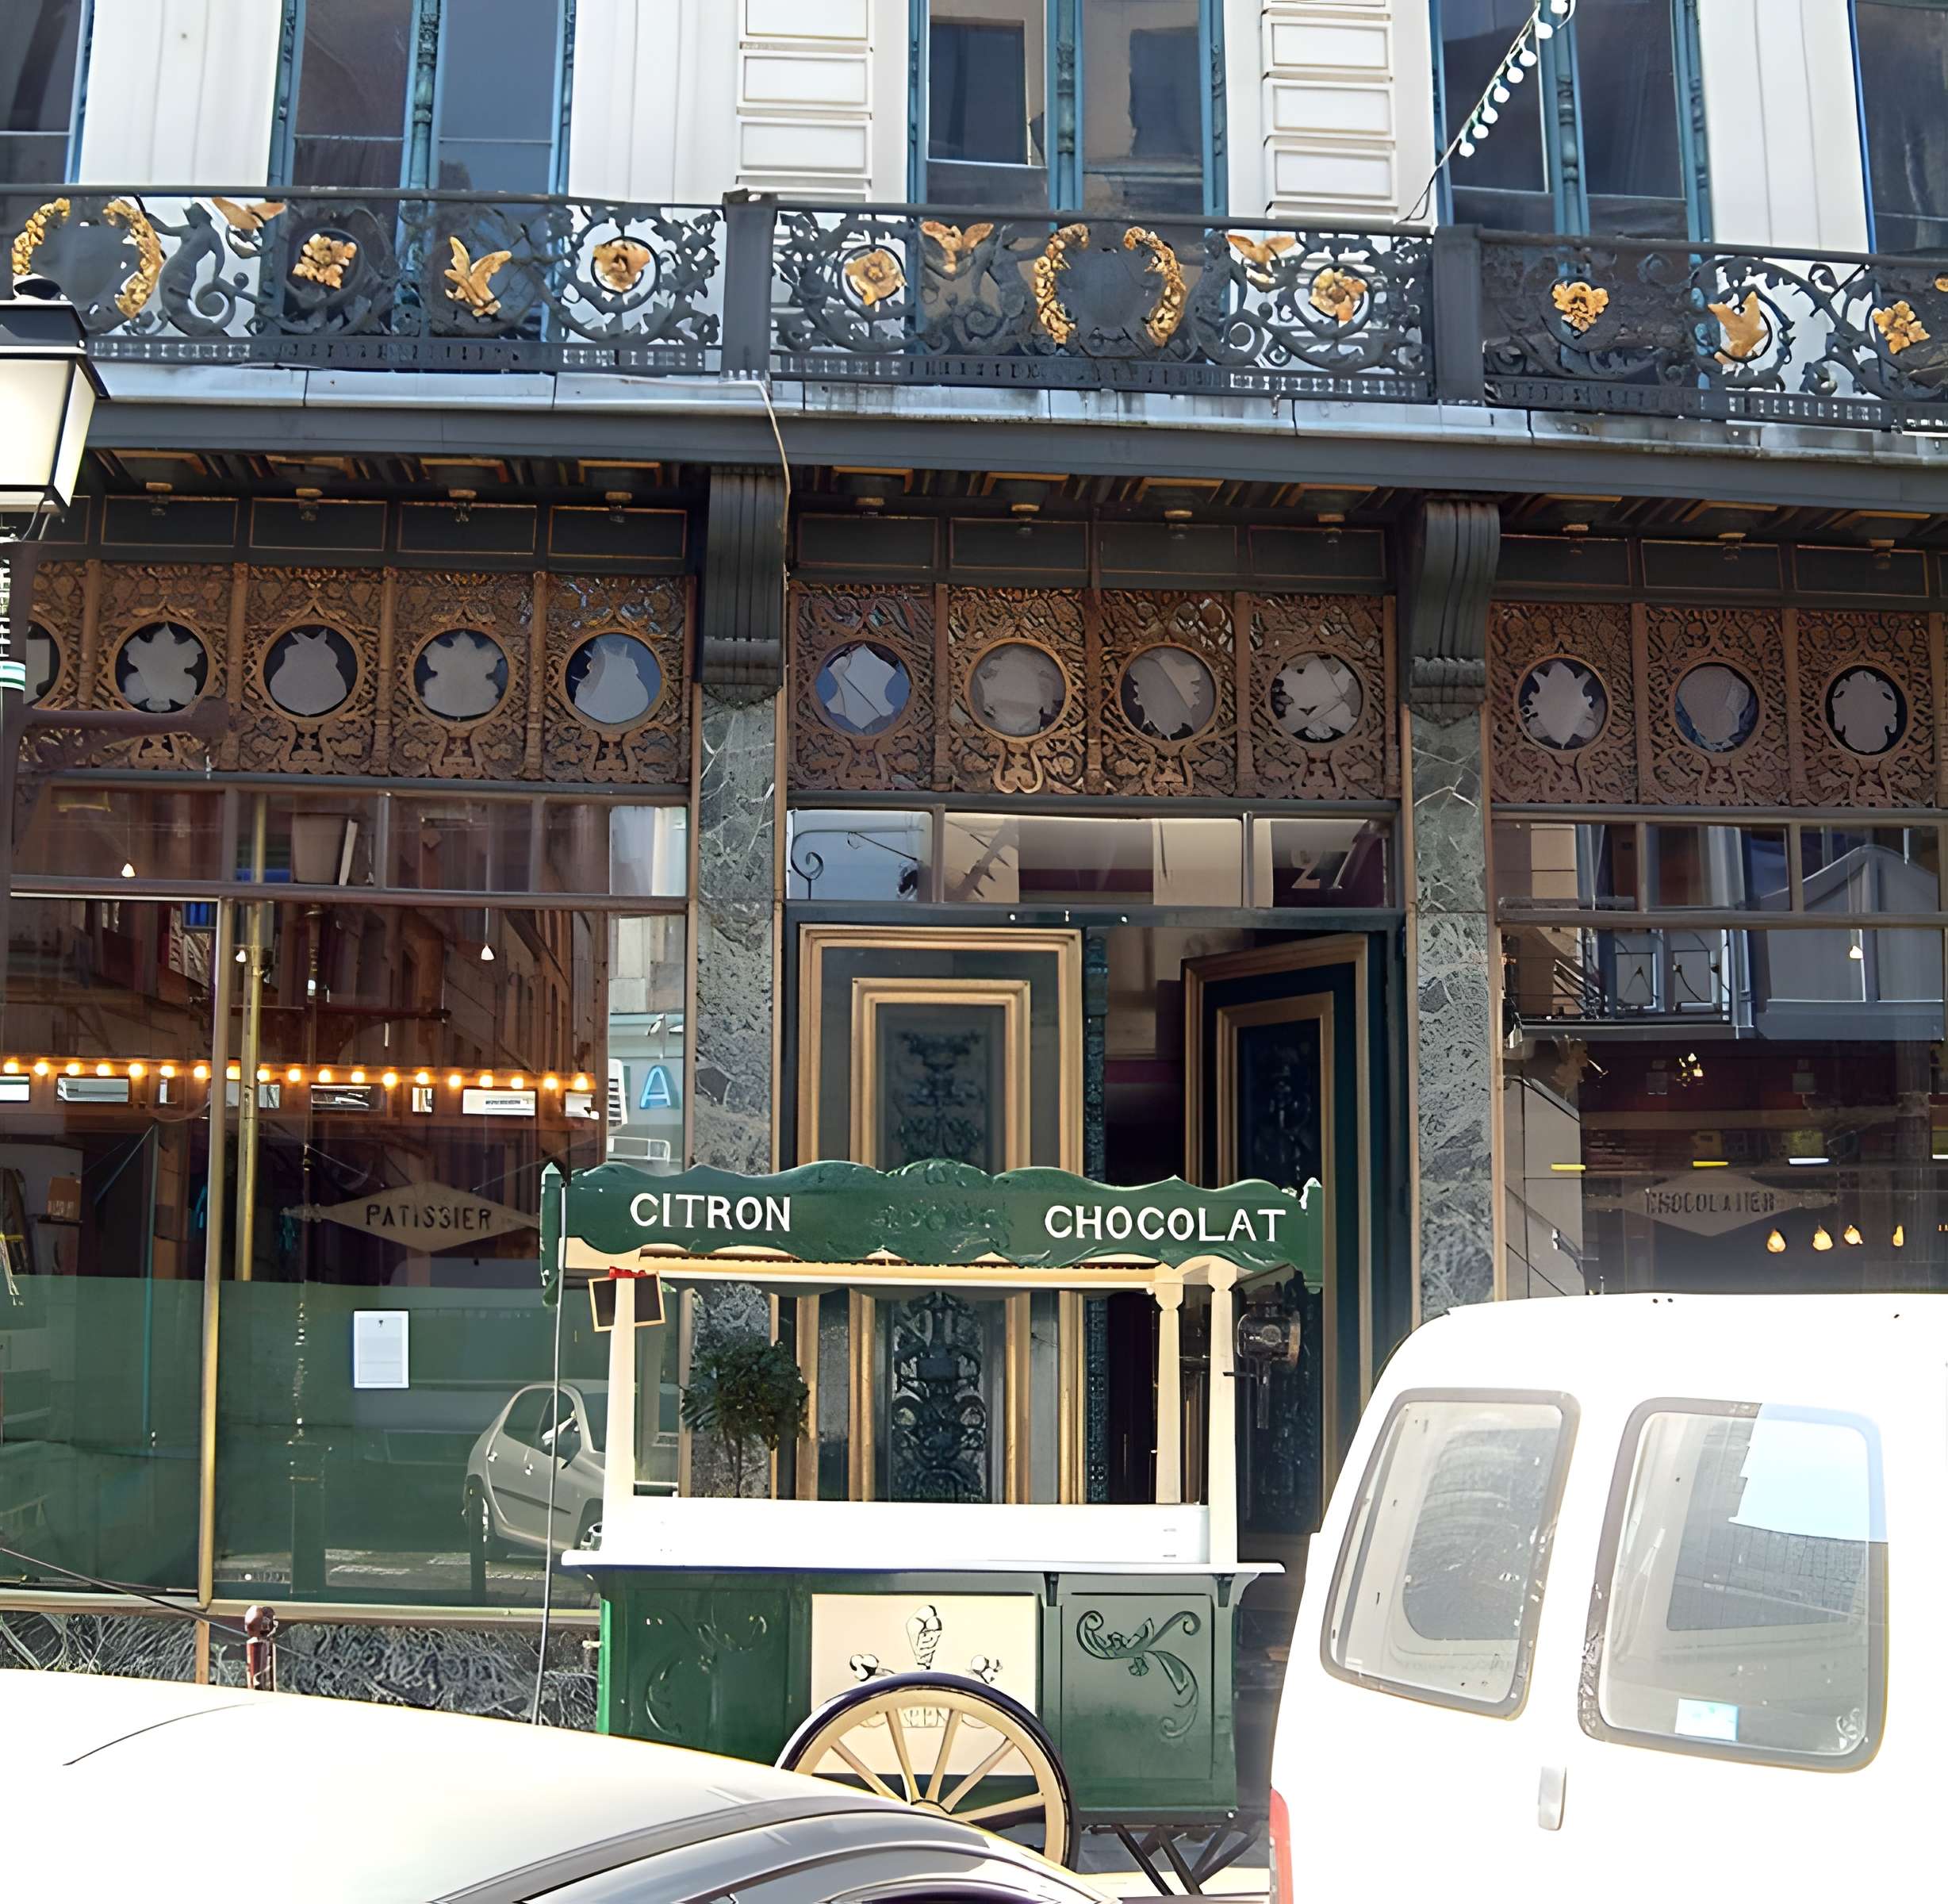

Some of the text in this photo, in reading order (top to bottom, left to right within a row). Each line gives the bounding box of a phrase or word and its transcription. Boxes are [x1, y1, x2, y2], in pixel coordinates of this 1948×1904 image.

[366, 1203, 492, 1230] PATISSIER
[630, 1192, 791, 1232] CITRON
[1045, 1205, 1287, 1242] CHOCOLAT
